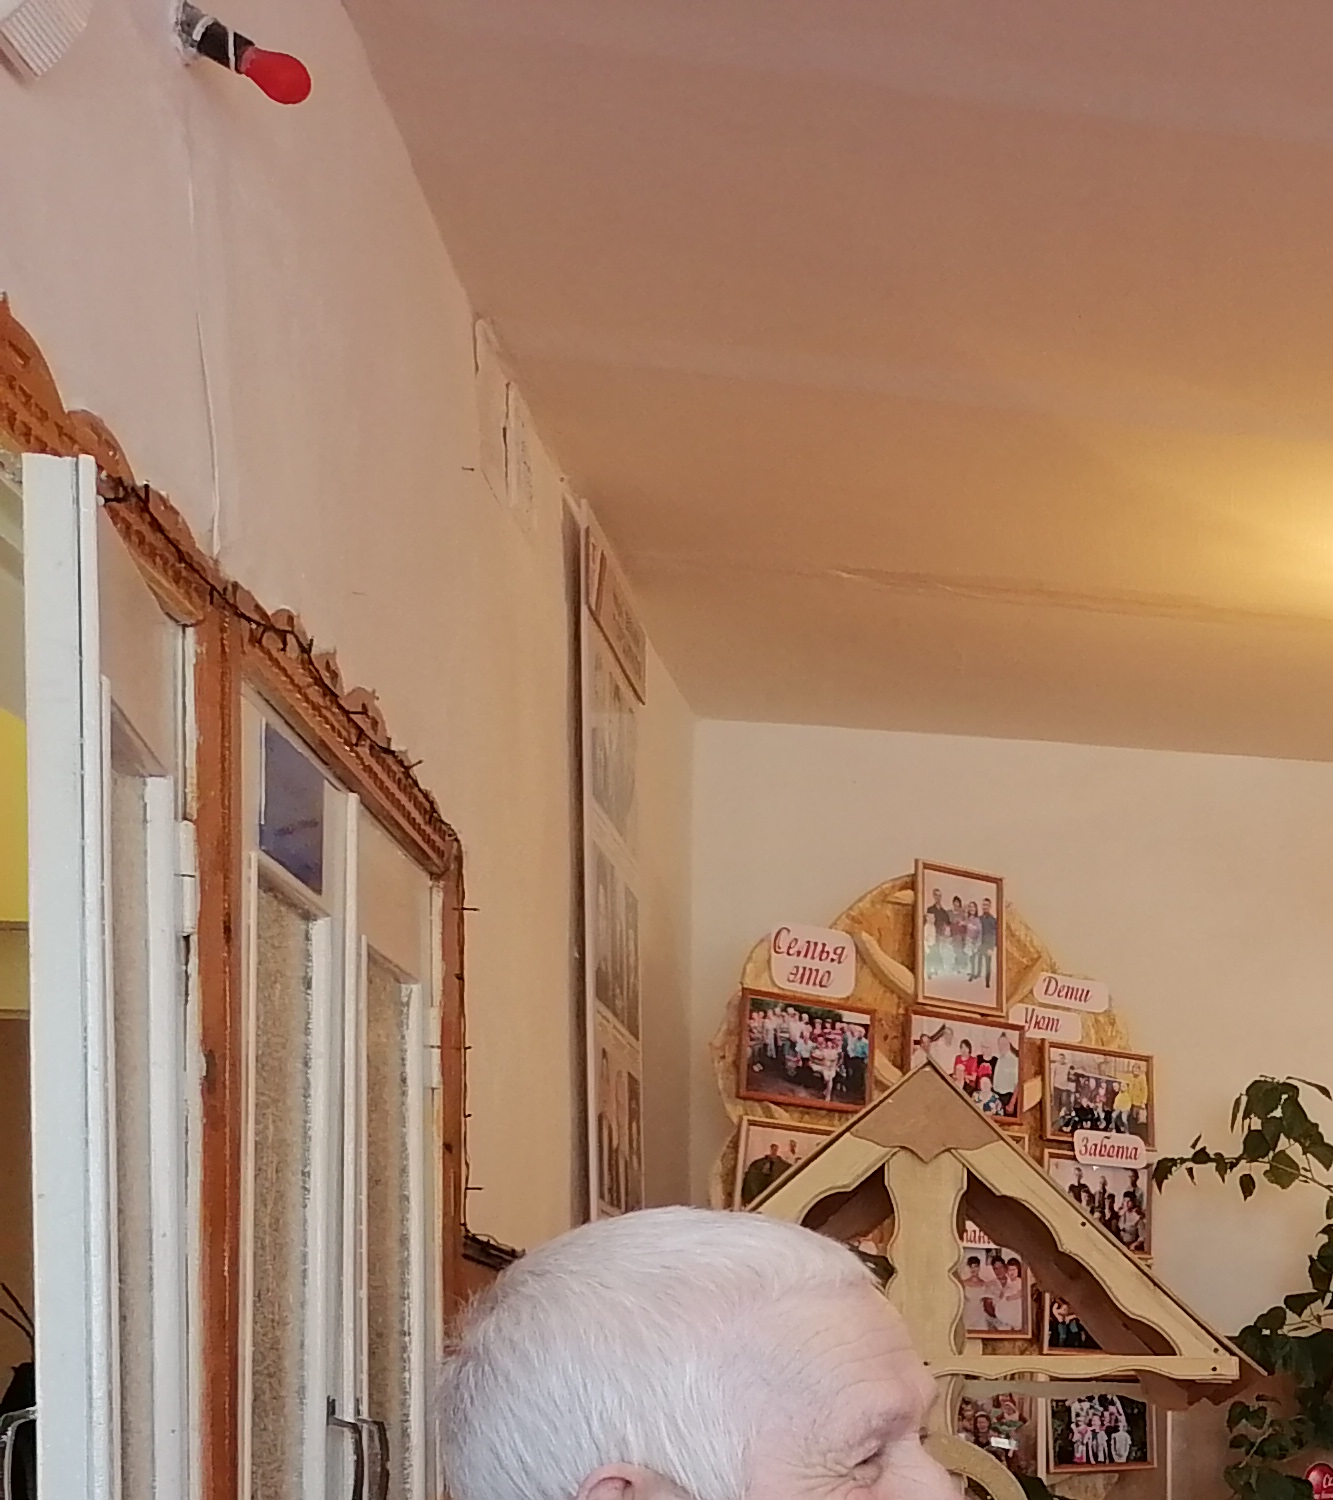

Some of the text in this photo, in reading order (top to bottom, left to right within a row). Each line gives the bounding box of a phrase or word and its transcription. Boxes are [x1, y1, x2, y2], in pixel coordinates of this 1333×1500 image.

[772, 926, 849, 965] Семья
[787, 965, 835, 989] это
[1042, 976, 1093, 1003] Дети
[1023, 1007, 1062, 1033] Уют
[1078, 1134, 1141, 1161] Забота
